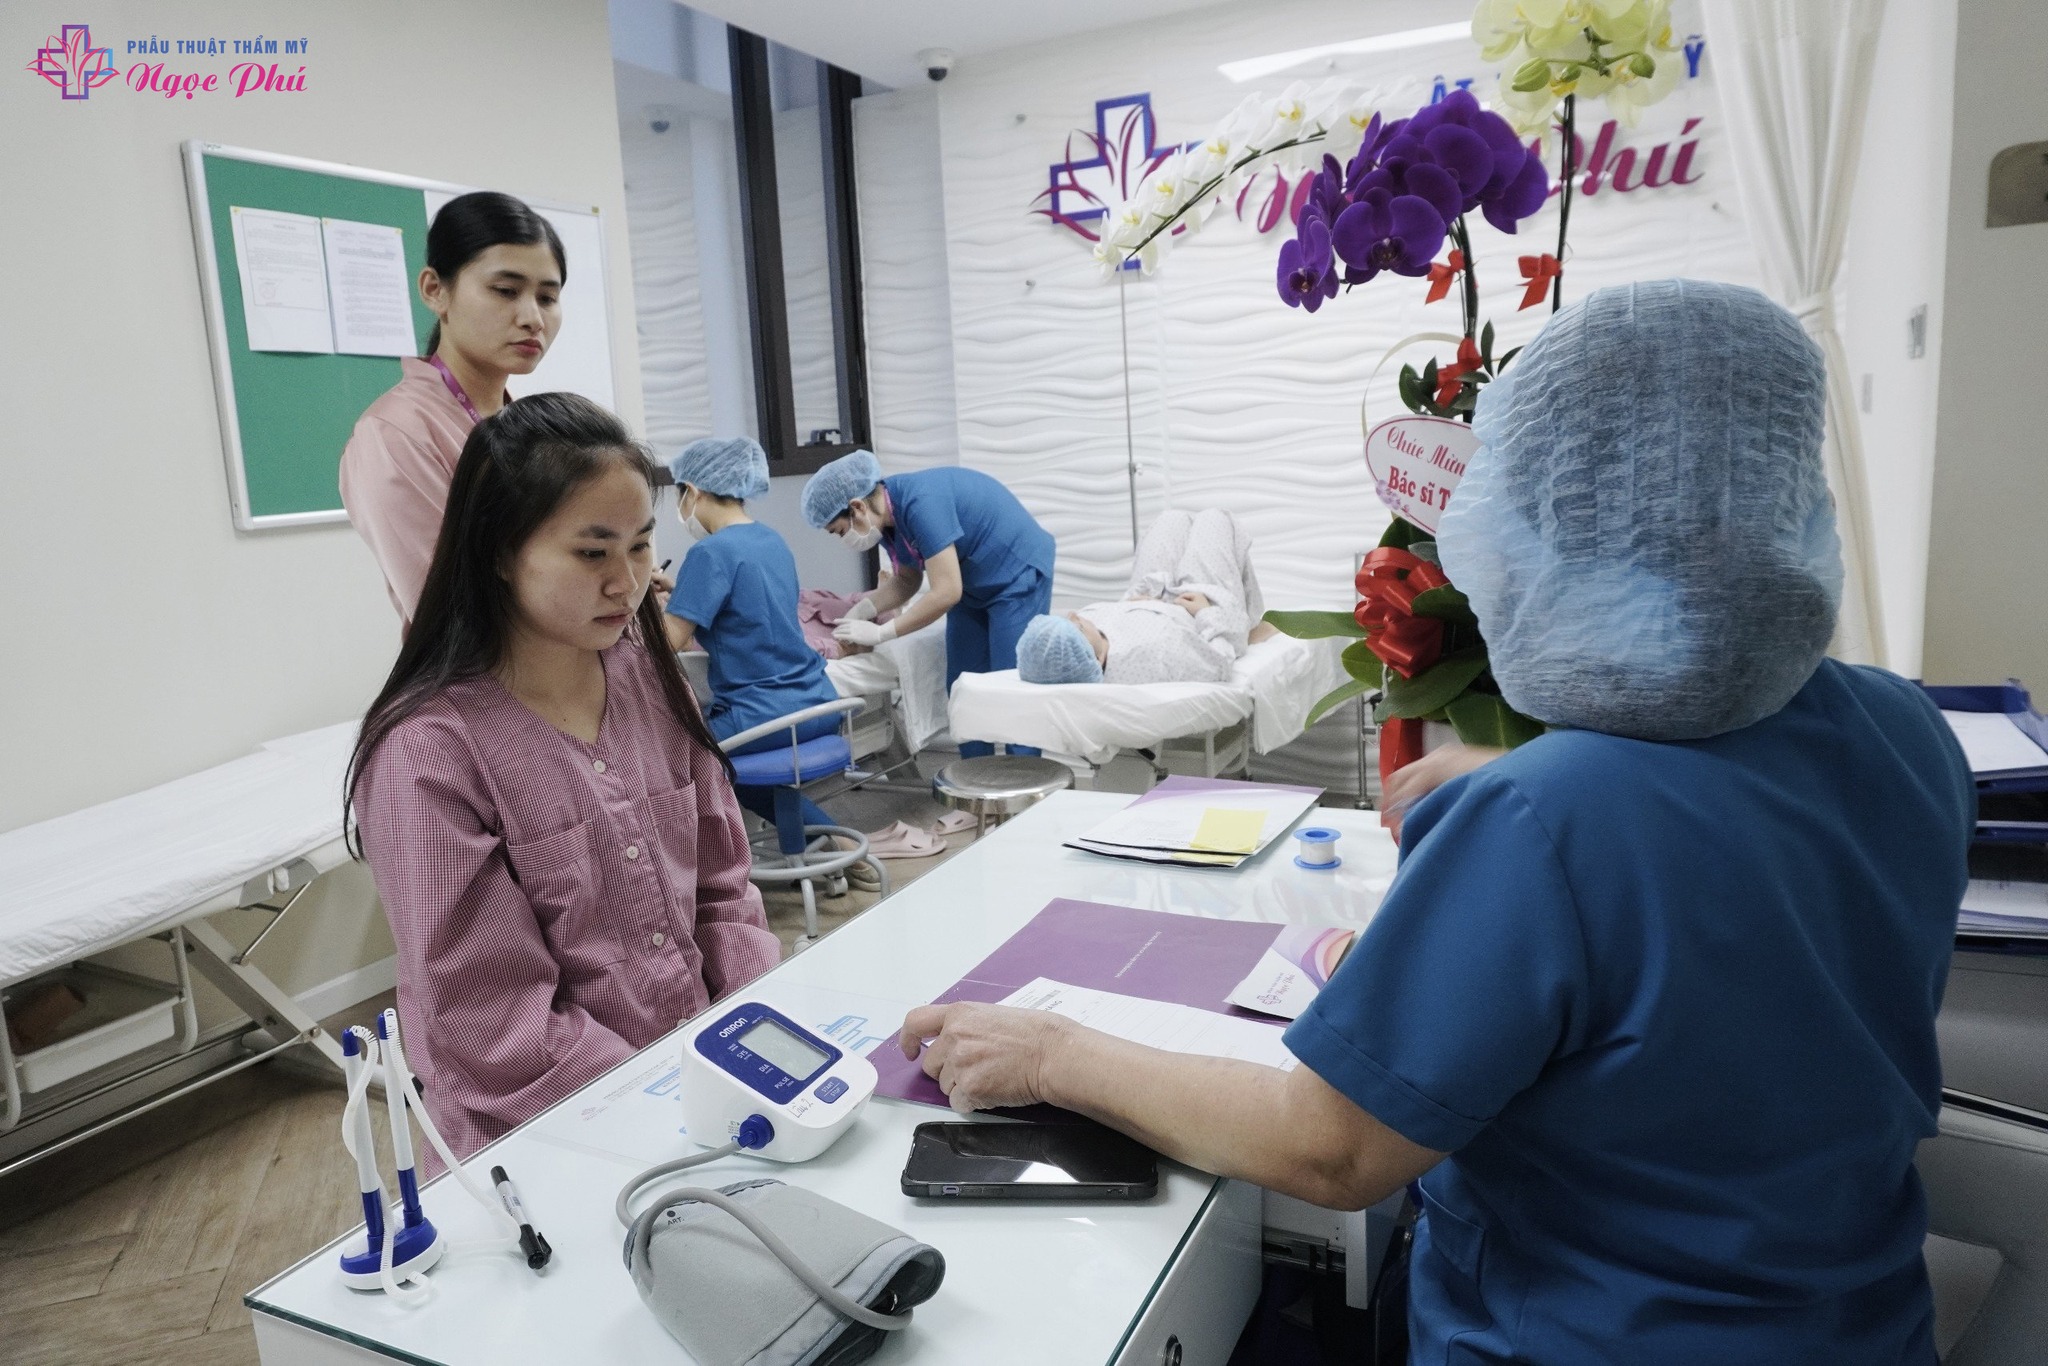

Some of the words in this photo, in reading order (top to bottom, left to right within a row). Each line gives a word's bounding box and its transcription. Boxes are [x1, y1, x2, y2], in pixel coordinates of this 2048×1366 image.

[1683, 34, 1705, 78] Ỹ
[1426, 443, 1466, 478] Mừn
[1387, 465, 1417, 498] Bác
[1419, 481, 1436, 506] sĩ
[1438, 486, 1452, 512] T
[736, 1049, 749, 1059] SYS
[758, 1063, 770, 1073] DIA
[774, 1076, 791, 1089] PULSE
[821, 1081, 835, 1093] START
[830, 1086, 842, 1097] STOP
